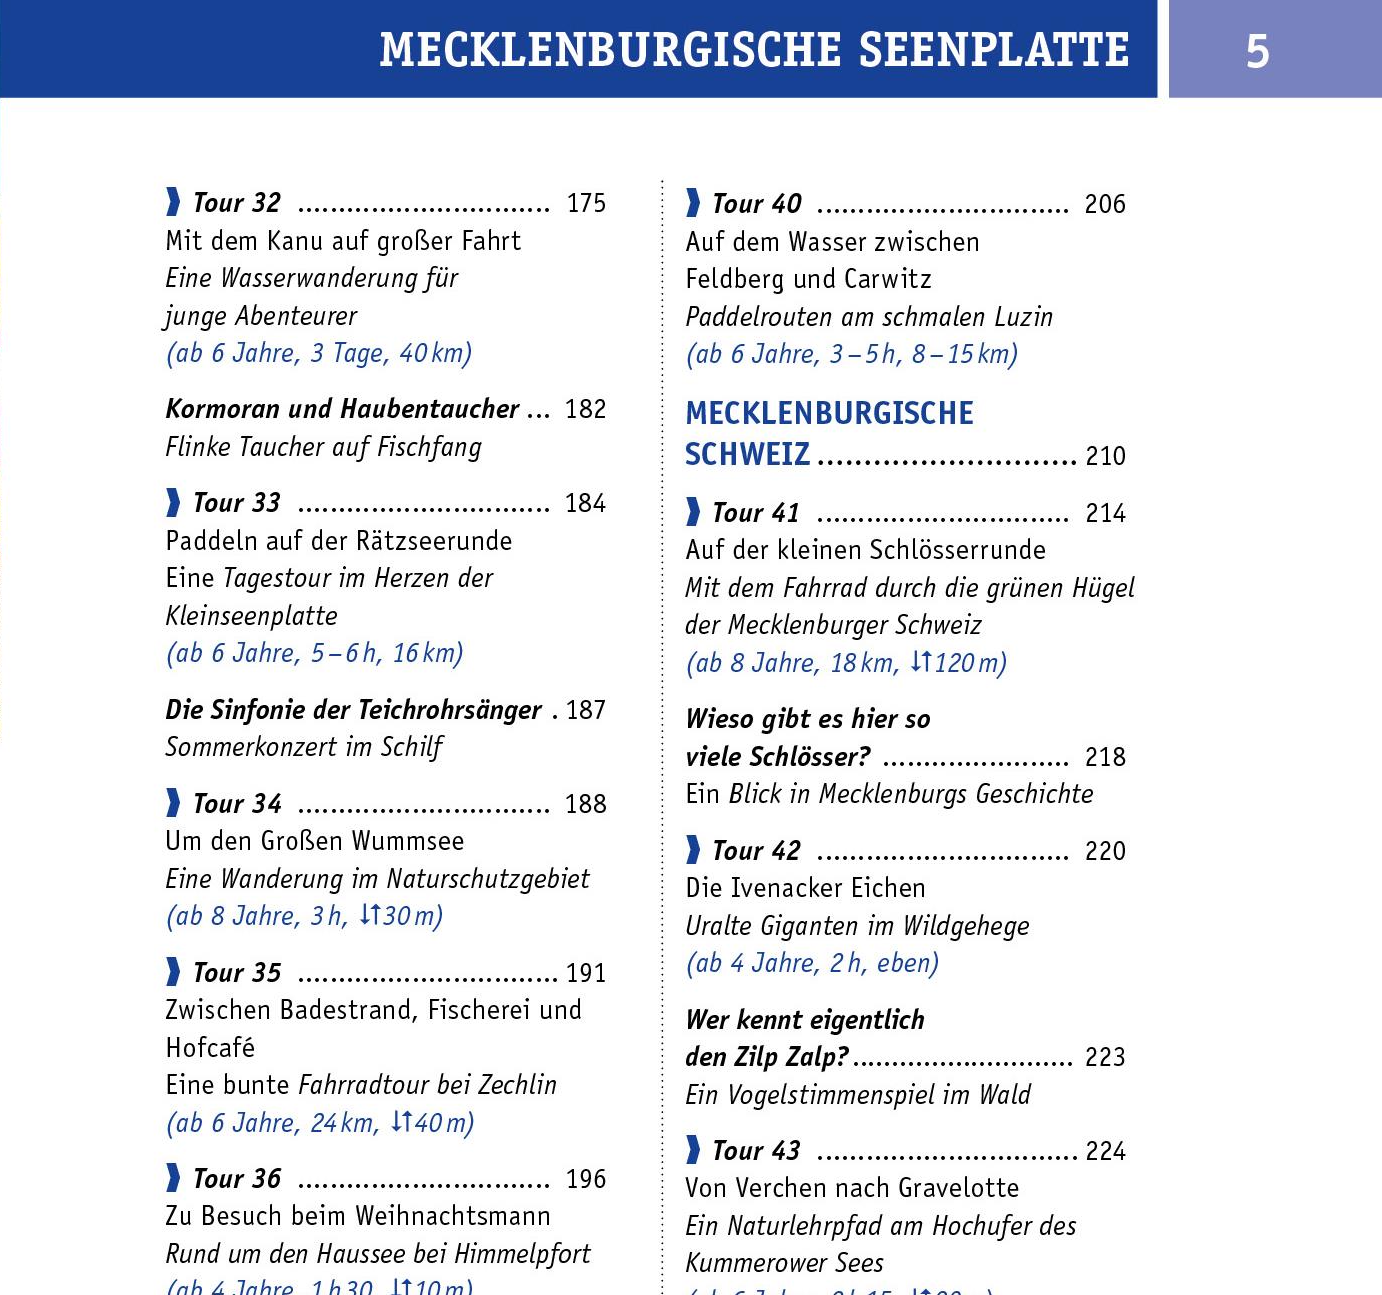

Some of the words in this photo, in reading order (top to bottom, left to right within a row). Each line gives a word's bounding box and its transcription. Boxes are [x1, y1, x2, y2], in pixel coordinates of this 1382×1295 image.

[379, 30, 841, 68] MECKLENBURGISCHE
[860, 30, 1129, 68] SEENPLATTE
[1247, 33, 1270, 69] 5
[194, 191, 245, 213] Tour
[251, 191, 282, 213] 32
[568, 192, 606, 213] 175
[713, 192, 765, 214] Tour
[771, 192, 803, 214] 40
[1085, 193, 1126, 214] 206
[166, 228, 203, 251] Mit
[211, 228, 257, 251] dem
[268, 229, 323, 251] Kanu
[332, 228, 370, 251] auf
[377, 228, 453, 257] großer
[463, 228, 522, 251] Fahrt
[687, 266, 784, 295] Feldberg
[794, 266, 836, 289] und
[844, 266, 932, 289] Carwitz
[160, 303, 227, 332] junge
[234, 303, 359, 326] Abenteurer
[686, 400, 974, 425] MECKLENBURGISCHE
[165, 434, 231, 457] Flinke
[240, 434, 326, 457] Taucher
[332, 434, 373, 463] auf
[377, 434, 483, 463] Fischfang
[685, 441, 811, 466] SCHWEIZ
[1086, 445, 1126, 466] 210
[687, 706, 754, 729] Wieso
[761, 706, 812, 735] gibt
[818, 713, 844, 729] es
[851, 706, 899, 729] hier
[904, 713, 931, 729] so
[164, 734, 338, 757] Sommerkonzert
[346, 734, 372, 757] im
[380, 734, 446, 763] Schilf
[687, 875, 722, 898] Die
[731, 875, 843, 898] Ivenacker
[852, 875, 925, 898] Eichen
[167, 1035, 255, 1058] Hofcafé
[165, 1204, 192, 1226] Zu
[202, 1203, 281, 1226] Besuch
[291, 1203, 345, 1226] beim
[355, 1203, 550, 1226] Weihnachtsmann
[685, 1251, 829, 1273] Kummerower
[834, 1251, 884, 1273] Sees
